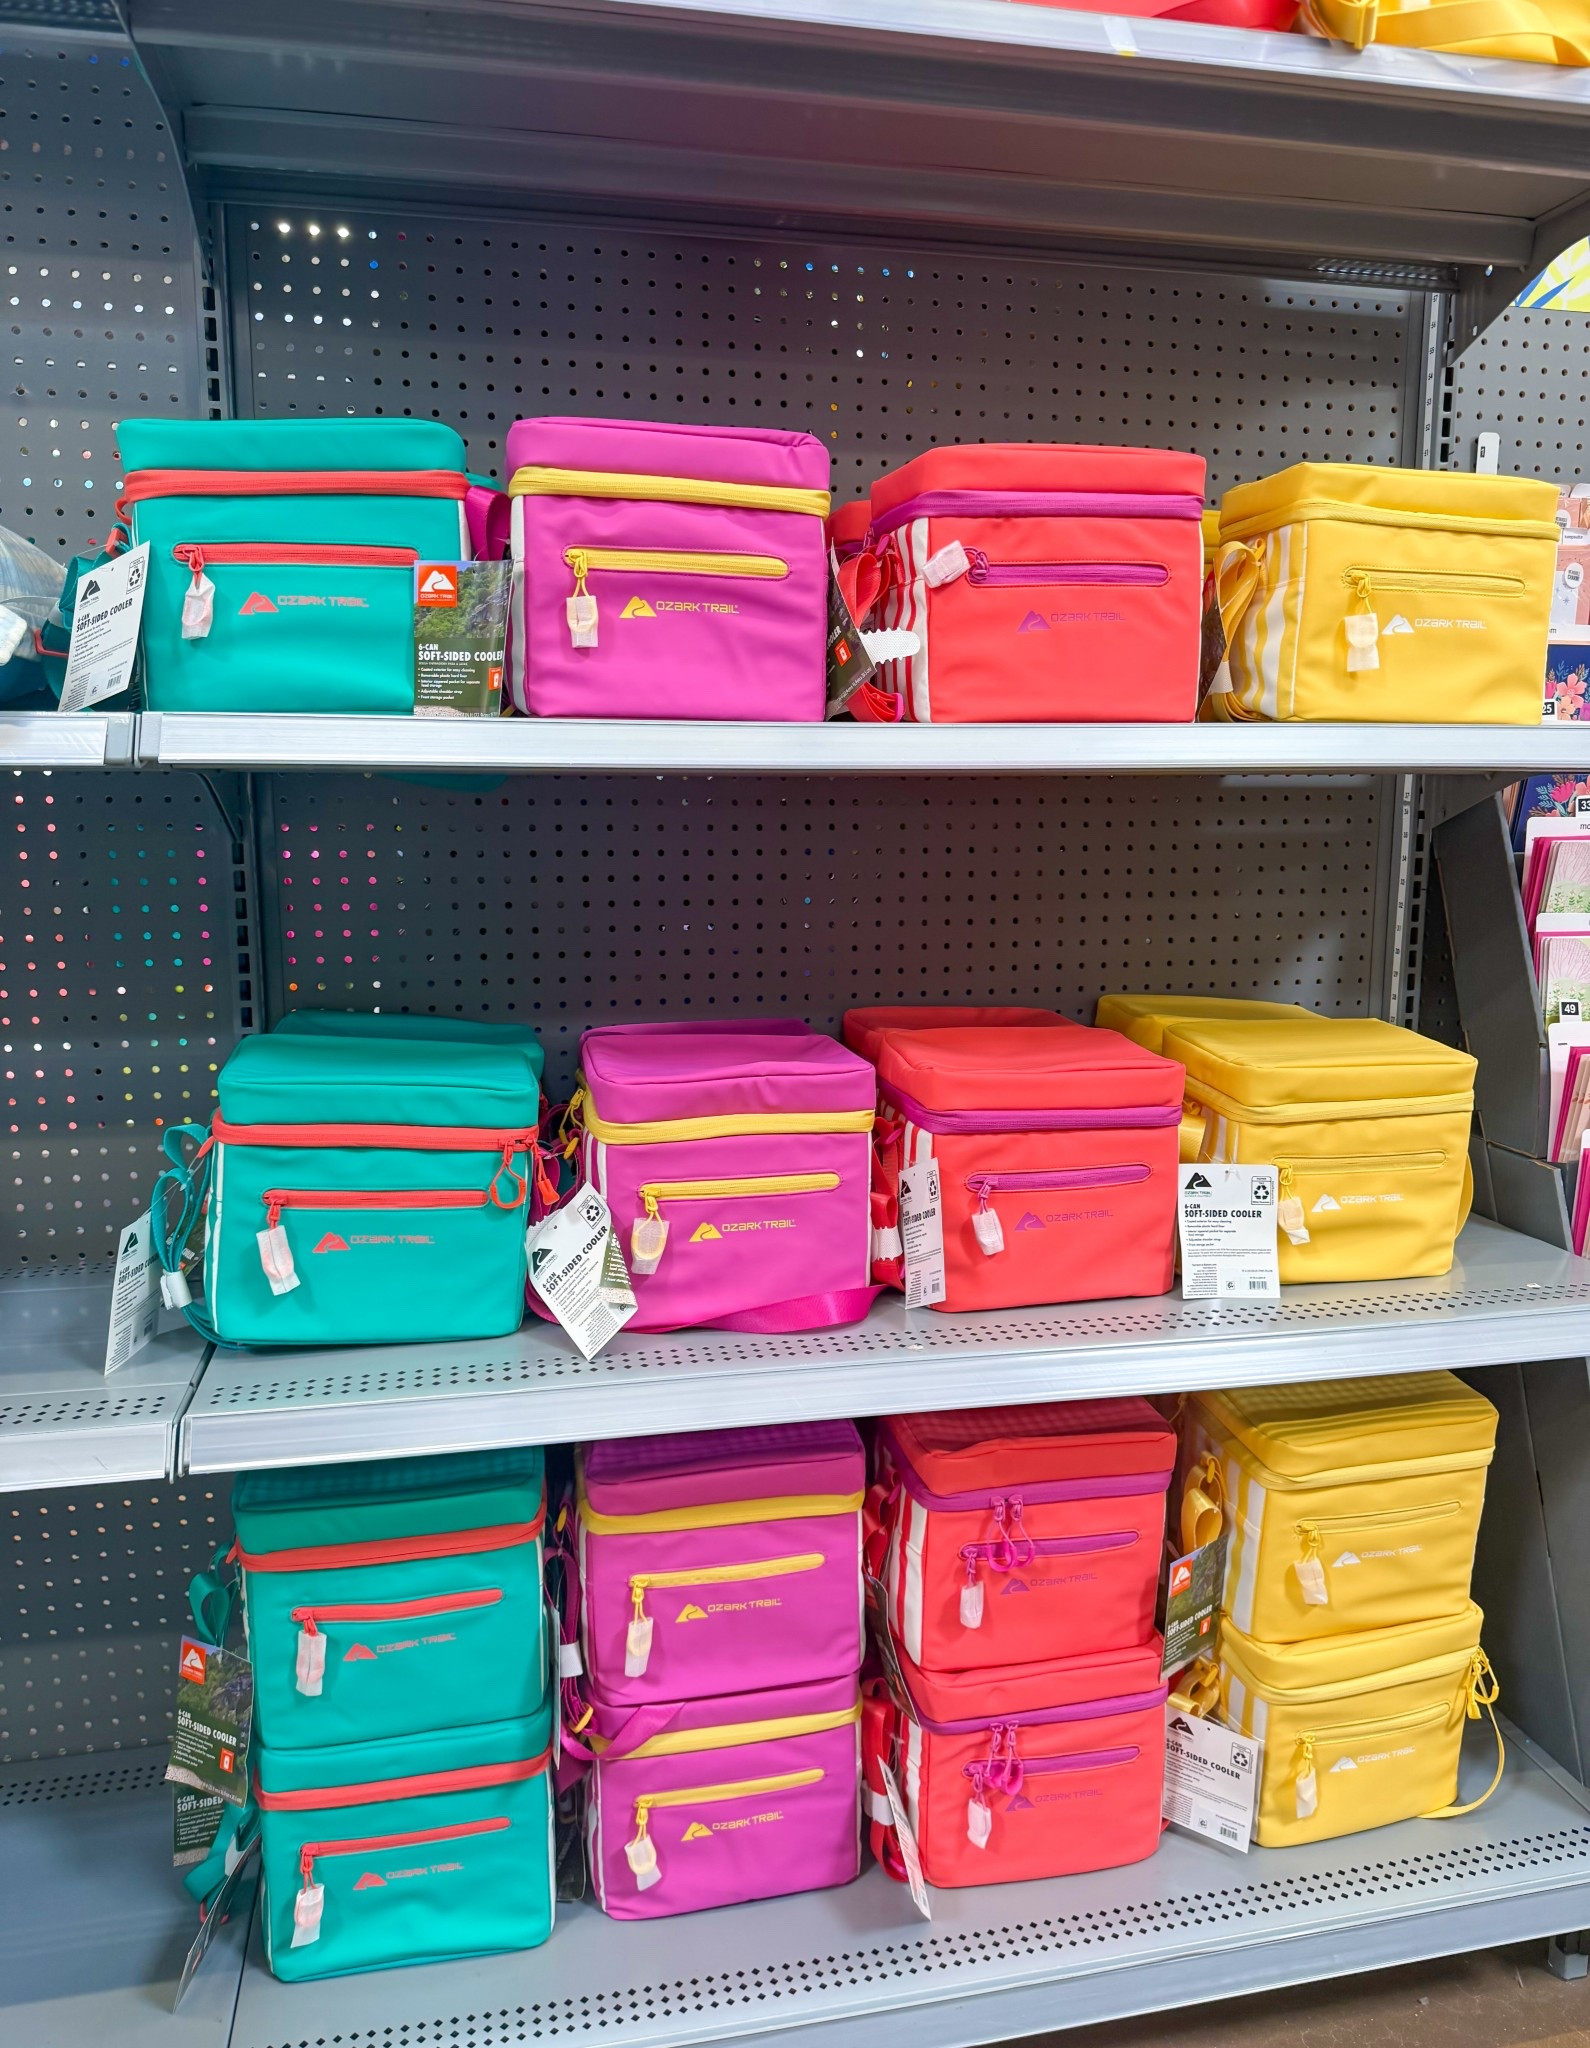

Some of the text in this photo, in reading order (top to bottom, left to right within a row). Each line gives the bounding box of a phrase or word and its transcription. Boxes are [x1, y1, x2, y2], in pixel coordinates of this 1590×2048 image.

[277, 595, 370, 608] OZARK TRAIL
[656, 601, 740, 614] OZARK TRAIL
[76, 597, 133, 633] SOFT-SIDED COOLER
[78, 613, 90, 623] 6-CAN
[1050, 611, 1126, 623] OZARK TRAIL
[1414, 617, 1487, 630] OZARK TRAIL
[418, 643, 438, 651] 6-CAN
[418, 651, 471, 661] SOFT-SIDED
[1564, 1003, 1577, 1015] 49
[1340, 1193, 1405, 1204] OZARK TRAIL
[1045, 1209, 1114, 1223] OZARK TRAIL
[1184, 1209, 1262, 1218] SOFT-SIDED COOLER
[721, 1219, 797, 1232] OZARK TRAIL
[350, 1235, 436, 1244] OZARK TRAIL
[545, 1254, 583, 1295] SOFT-SIDED
[582, 1225, 608, 1256] COOLER
[542, 1271, 557, 1289] 6-CAN
[1361, 1544, 1423, 1558] OZARK TRAIL
[1030, 1573, 1098, 1587] OZARK TRAIL
[707, 1598, 782, 1613] OZARK TRAIL
[376, 1631, 457, 1653] OZARK TRAIL
[177, 1715, 212, 1736] SOFT-SIDED
[212, 1729, 237, 1747] COOLER
[1166, 1742, 1241, 1780] SOFT-SIDED COOLER
[1357, 1745, 1416, 1763] OZARK TRAIL
[177, 1794, 195, 1804] 6-CAN
[1035, 1788, 1104, 1803] OZARK TRAIL
[177, 1796, 224, 1813] SOFT-SIDED
[712, 1811, 784, 1830] OZARK TRAIL
[386, 1861, 464, 1879] OZARK TRAIL
